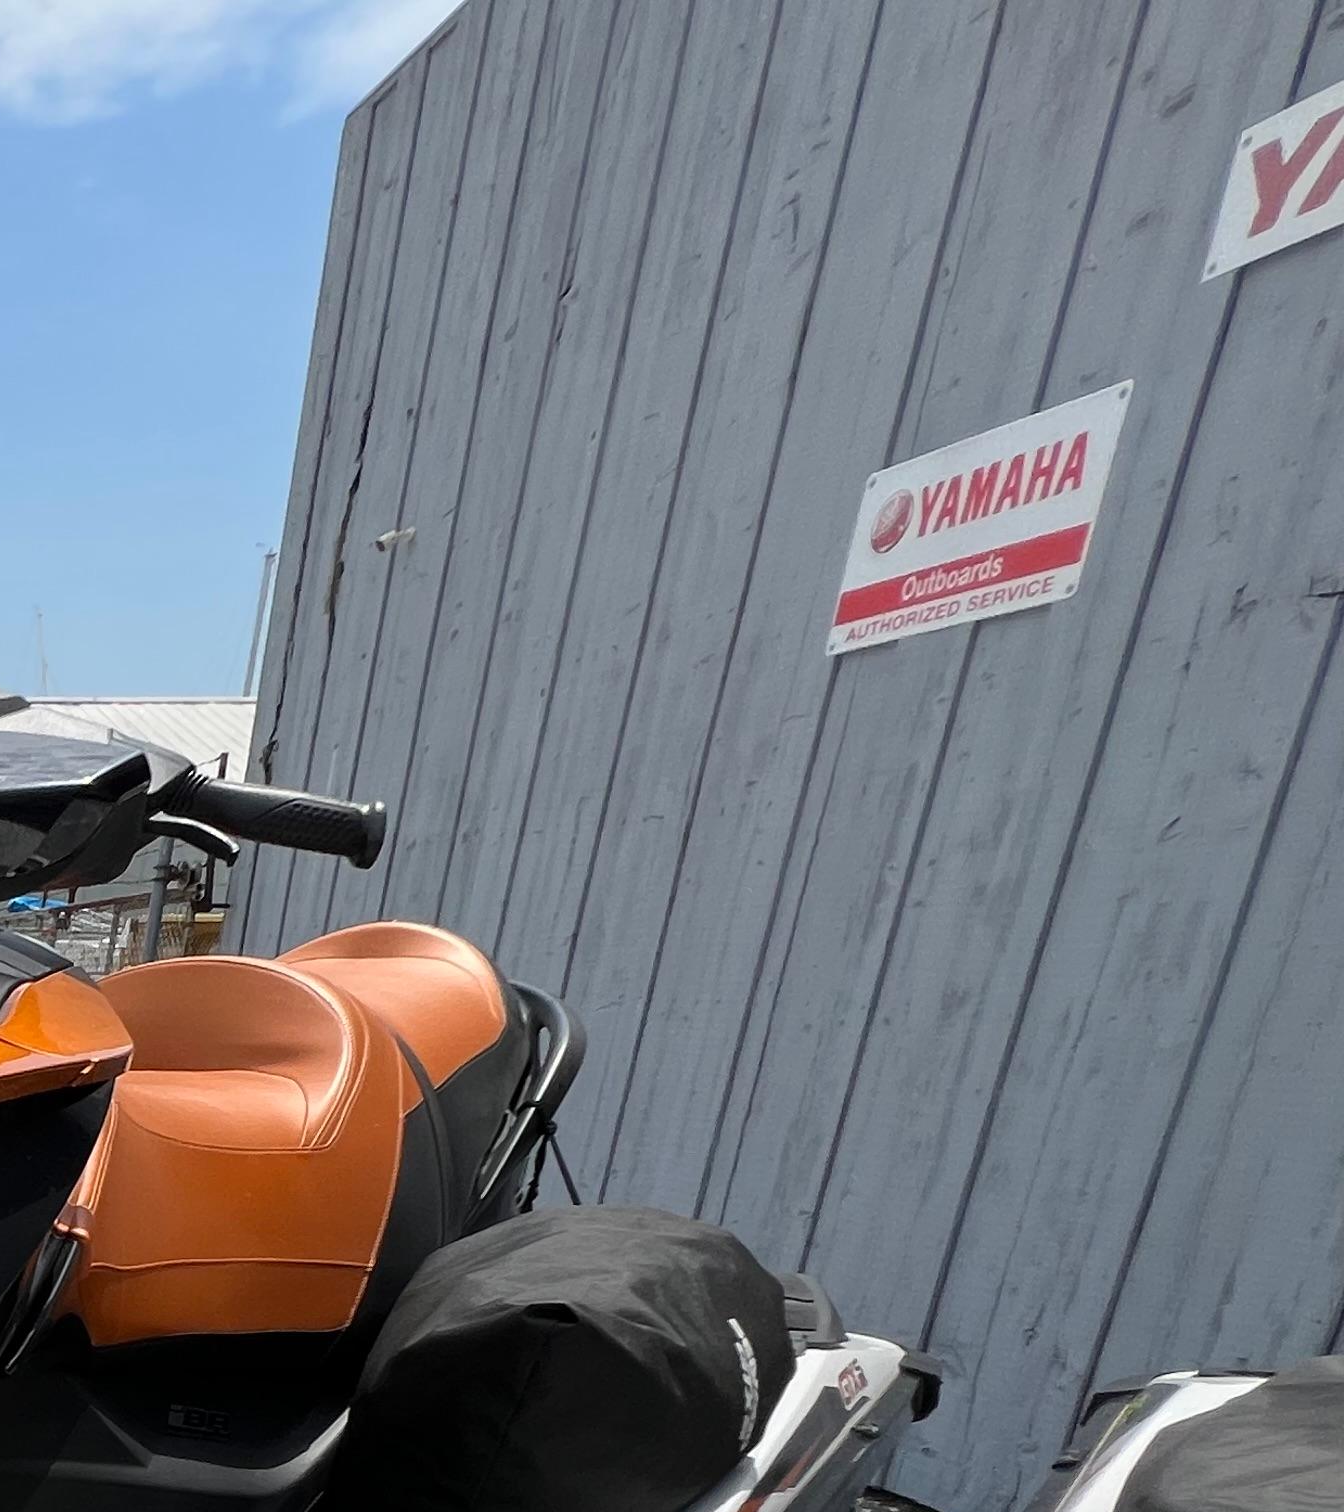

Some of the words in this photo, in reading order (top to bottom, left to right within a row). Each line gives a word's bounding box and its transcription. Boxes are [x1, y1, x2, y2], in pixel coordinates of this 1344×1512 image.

[917, 432, 1089, 538] YAMAHA
[845, 602, 961, 643] AUTHORIZED
[966, 576, 1056, 612] SERVICE
[902, 554, 1004, 601] Outboards
